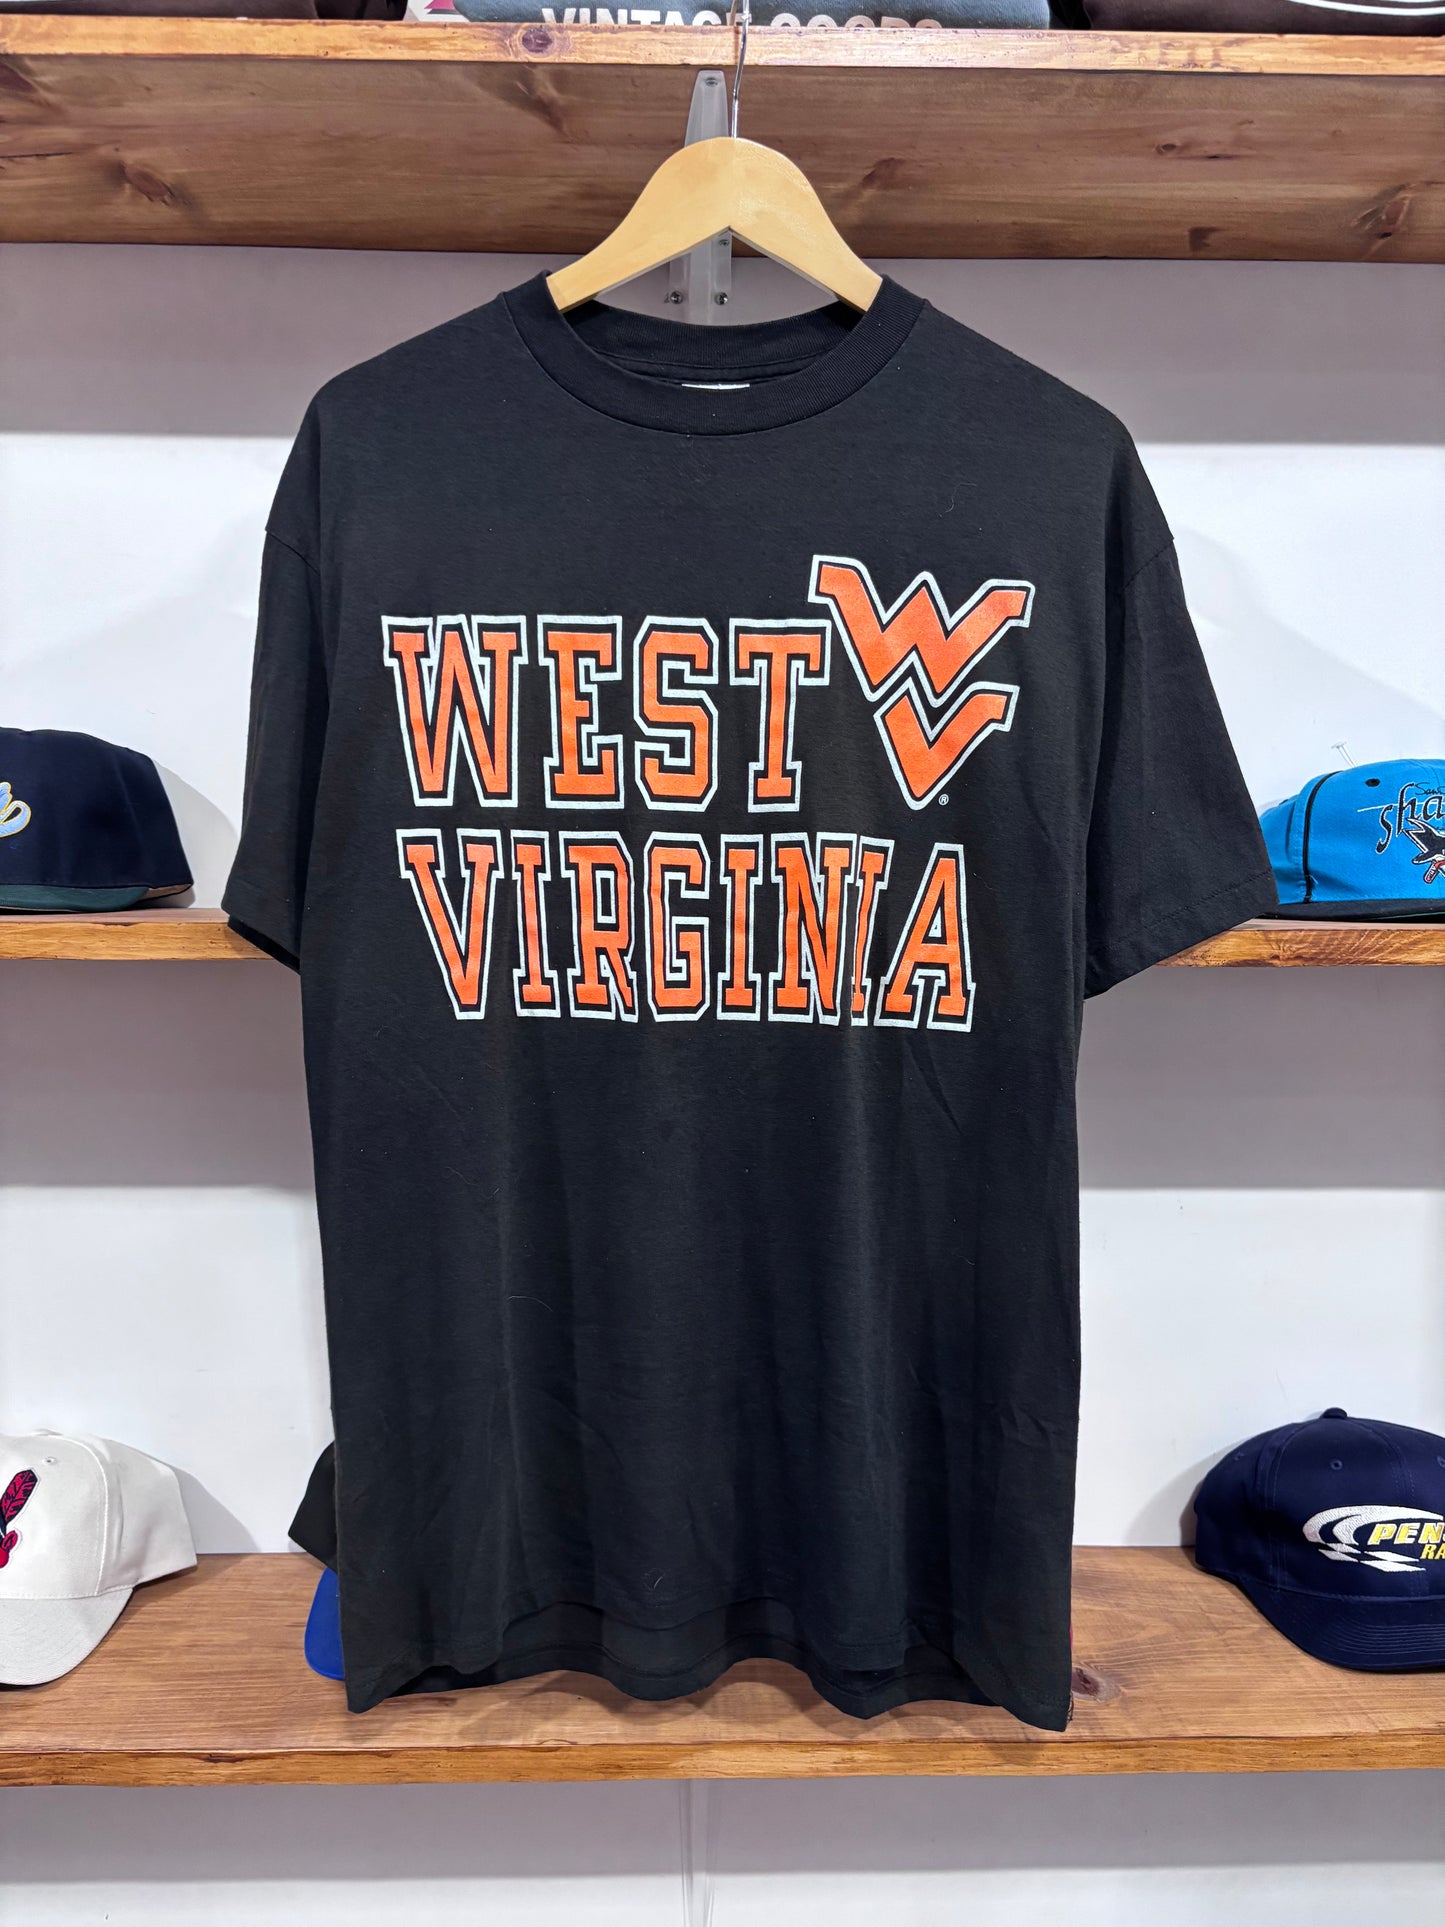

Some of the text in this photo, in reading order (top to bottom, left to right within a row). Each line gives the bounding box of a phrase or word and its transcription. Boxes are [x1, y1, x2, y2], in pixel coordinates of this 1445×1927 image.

[381, 614, 832, 812] WEST
[396, 829, 976, 1032] VIRGINIA
[1367, 1522, 1445, 1545] PEN
